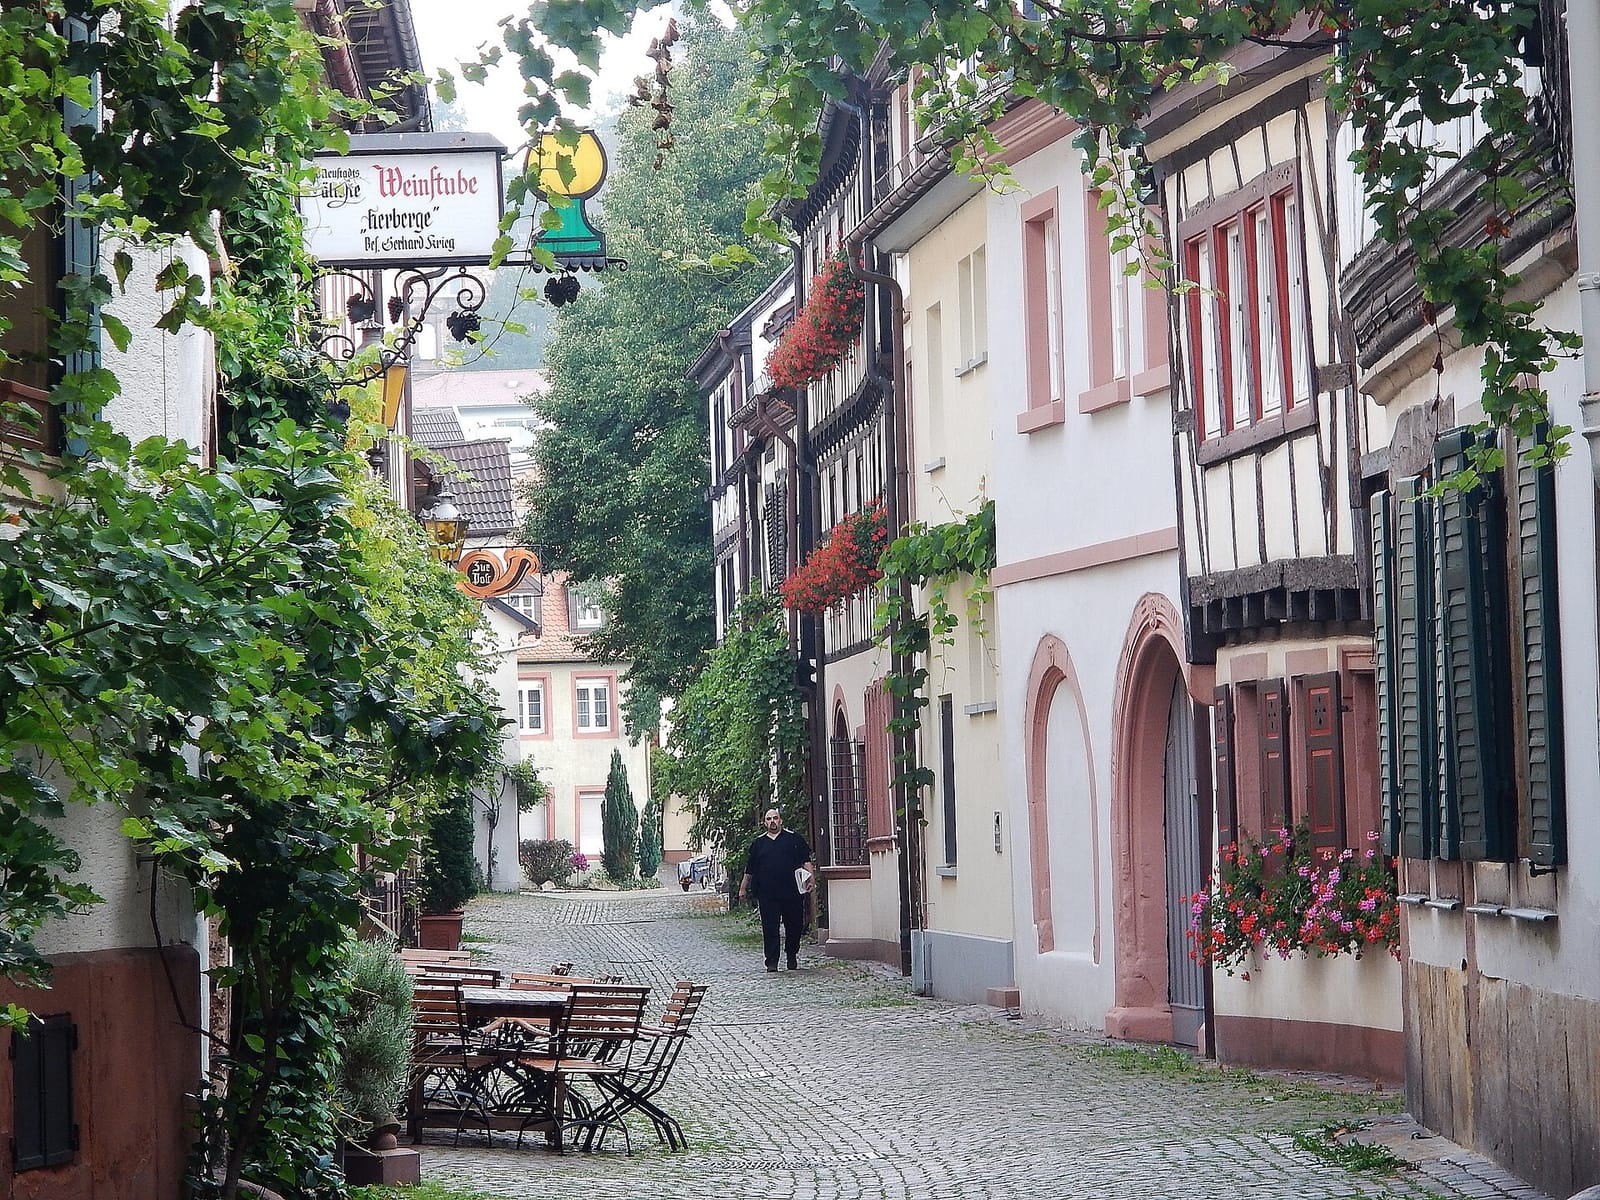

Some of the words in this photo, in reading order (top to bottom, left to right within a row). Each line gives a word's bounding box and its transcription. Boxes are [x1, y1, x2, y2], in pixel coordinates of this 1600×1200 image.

[372, 164, 479, 202] Weinstube
[381, 235, 424, 252] Gerhard
[425, 234, 455, 252] Krieg
[471, 572, 492, 585] Post
